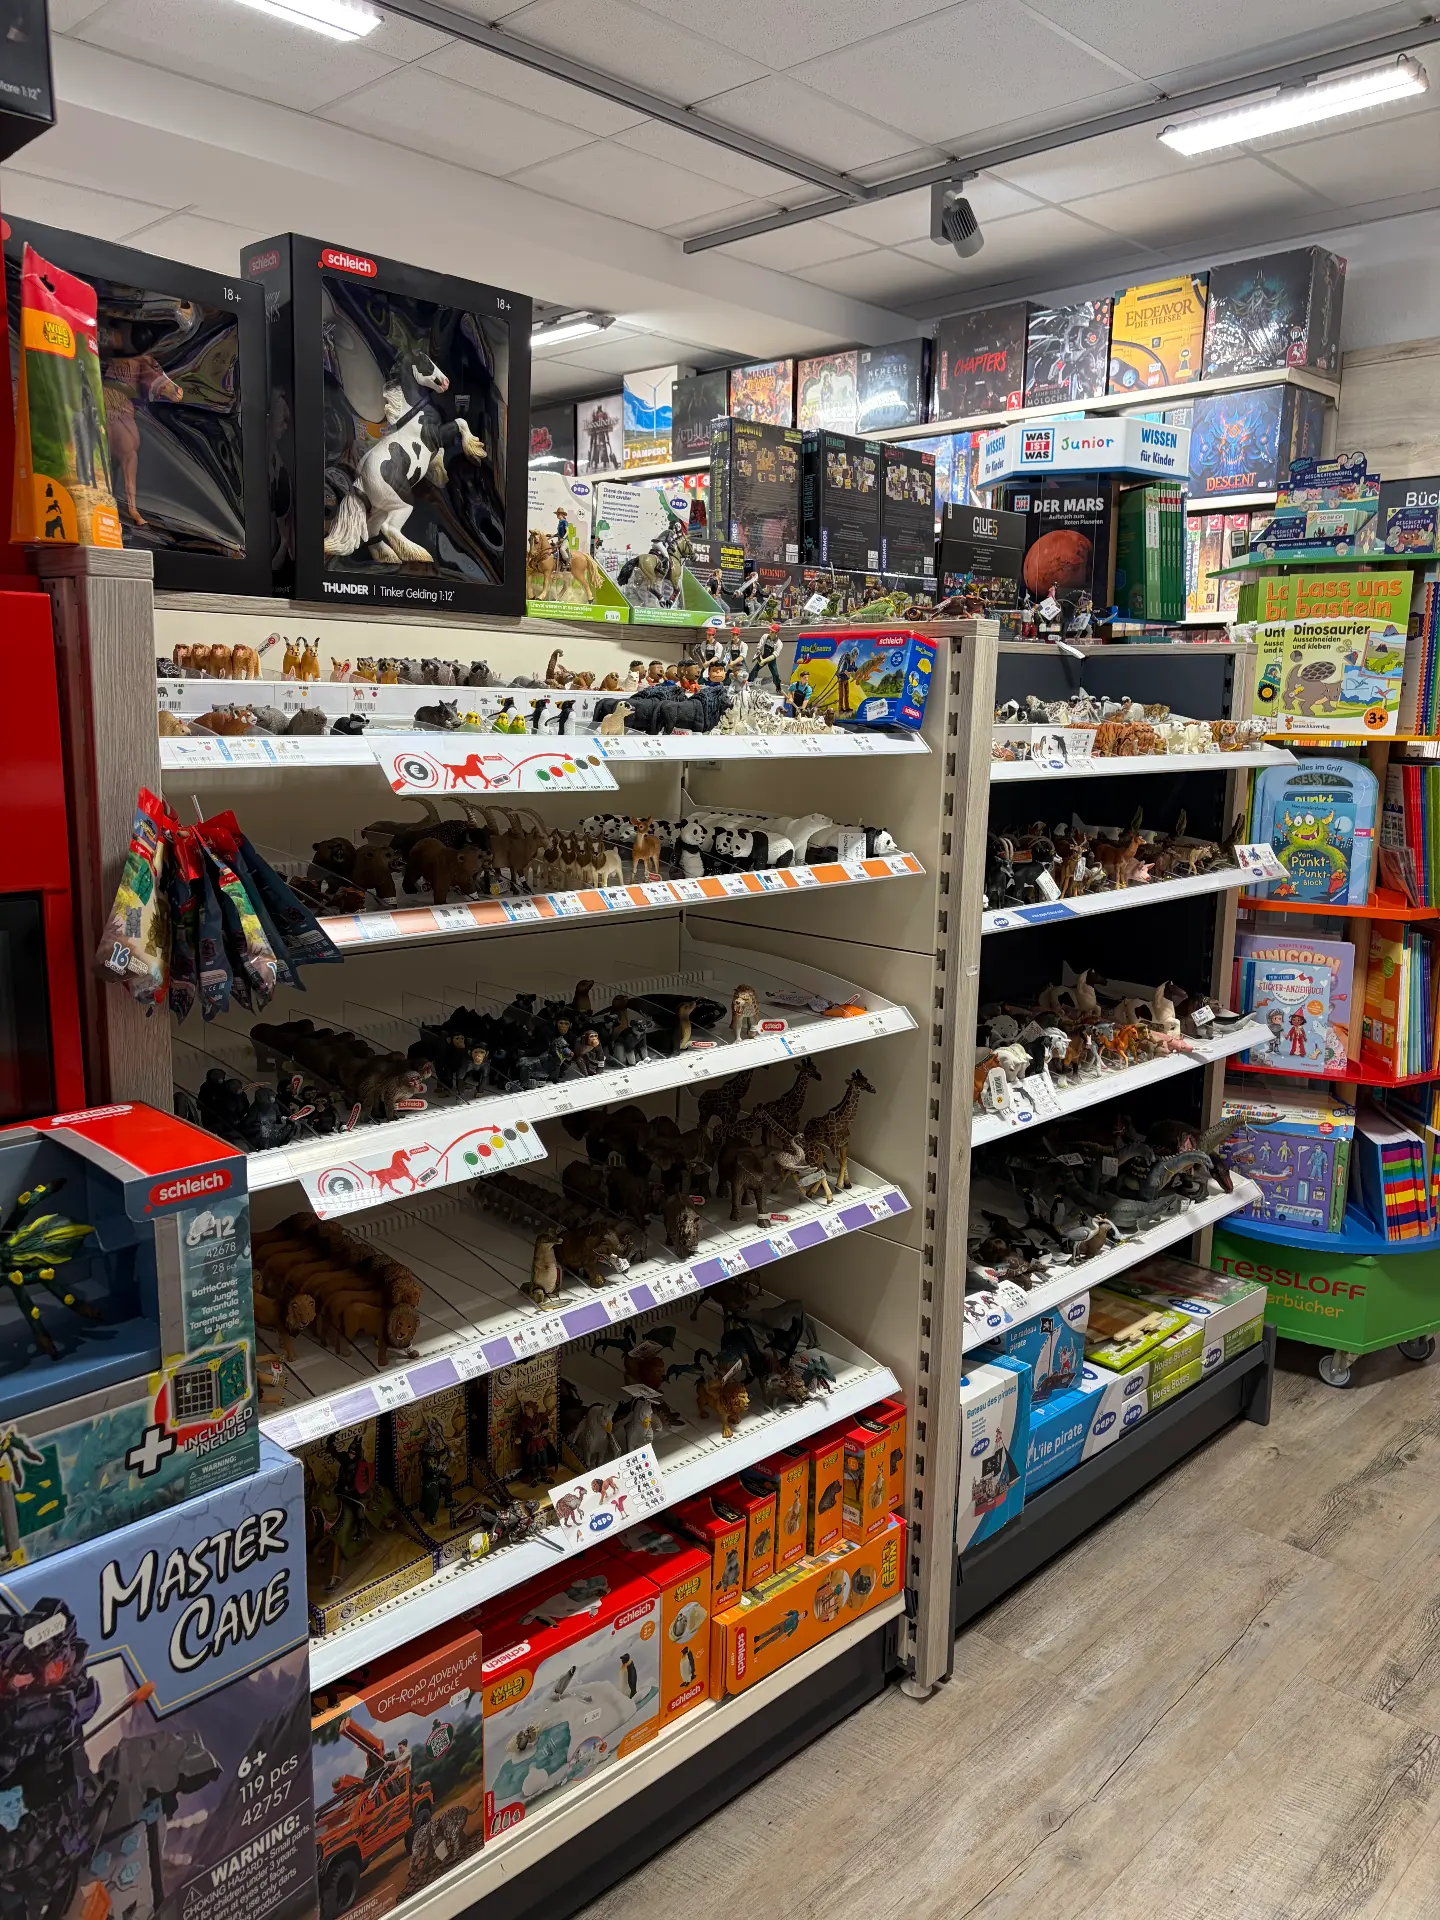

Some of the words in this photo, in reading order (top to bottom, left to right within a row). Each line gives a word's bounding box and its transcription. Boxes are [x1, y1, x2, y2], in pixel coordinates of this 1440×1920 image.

[251, 254, 277, 271] schleich
[328, 253, 371, 273] schleich
[223, 287, 242, 303] 18+
[496, 297, 512, 311] 18+
[1125, 298, 1196, 328] ENDEAVOR
[1134, 318, 1150, 329] DIE
[1150, 313, 1182, 326] TIEFSEE
[44, 320, 69, 338] WILD
[47, 333, 70, 348] LIFE
[868, 364, 908, 377] NEMESIS
[953, 350, 1007, 377] CHAPTERS
[747, 368, 774, 379] MARVEL
[1027, 394, 1067, 406] MOLOCHS
[1026, 431, 1050, 441] WAS
[1061, 436, 1115, 450] Junior
[1141, 427, 1178, 448] WISSEN
[631, 447, 667, 459] PAMPERO
[985, 435, 1005, 457] WISSEN
[1029, 442, 1047, 450] IST
[1025, 450, 1050, 460] WAS
[1140, 450, 1152, 463] für
[1152, 452, 1175, 466] Kinder
[991, 459, 1004, 472] Kinder
[573, 484, 590, 494] papo
[1205, 472, 1257, 492] DESCENT
[671, 500, 688, 509] papo
[1034, 499, 1060, 514] DER
[1063, 497, 1104, 513] MARS
[972, 516, 998, 537] CLUE5
[1080, 518, 1104, 526] Planeten
[322, 581, 369, 596] THUNDER
[380, 586, 404, 598] Tinker
[405, 588, 437, 603] Gelding
[1296, 578, 1351, 598] Lass
[1356, 579, 1403, 597] uns
[1294, 598, 1392, 618] basteln
[1293, 622, 1370, 636] Dinosaurier
[801, 643, 832, 653] Dinosaurs
[879, 636, 904, 645] schleich
[1292, 635, 1341, 644] Ausschneiden
[904, 706, 920, 718] schleich
[1368, 713, 1385, 725] 3+
[1298, 763, 1314, 772] Alles
[1326, 764, 1344, 774] Griff
[1291, 857, 1331, 868] Punkt-
[1298, 869, 1331, 879] Punkt-
[1303, 879, 1323, 887] Block
[111, 943, 129, 967] 16
[1250, 949, 1341, 976] UNICORN
[1258, 981, 1324, 996] STICKER-ANZIEHBUCH
[62, 1104, 125, 1122] schleich
[1226, 1108, 1279, 1118] SCHABLONEN
[159, 1174, 224, 1201] schleich
[206, 1242, 236, 1259] 42678
[212, 1262, 225, 1275] 28
[226, 1263, 238, 1273] pcs
[191, 1277, 238, 1298] BattleCave:
[212, 1288, 239, 1304] Jungle
[201, 1298, 239, 1315] Tarantula
[1070, 1306, 1085, 1320] papo
[1174, 1300, 1208, 1314] papo
[190, 1312, 227, 1331] Tarentule
[228, 1308, 240, 1318] de
[204, 1325, 213, 1335] la
[213, 1317, 240, 1334] Jungle
[988, 1315, 1001, 1325] papo
[1011, 1332, 1019, 1341] Le
[1018, 1326, 1037, 1338] radeau
[1010, 1339, 1027, 1353] pirate
[1154, 1357, 1174, 1373] Horse
[1173, 1345, 1192, 1360] Boxes
[1205, 1351, 1221, 1365] papo
[1126, 1379, 1143, 1394] papo
[1152, 1383, 1171, 1402] Horse
[1171, 1373, 1190, 1389] Boxes
[967, 1402, 987, 1420] Bateau
[987, 1396, 998, 1408] des
[997, 1384, 1017, 1404] pirates
[1125, 1406, 1142, 1423] papo
[183, 1406, 253, 1453] INCLUDED
[1095, 1414, 1115, 1434] papo
[196, 1421, 247, 1458] INCLUS
[1055, 1422, 1083, 1453] pirate
[973, 1440, 988, 1455] papo
[201, 1455, 237, 1474] WARNING:
[189, 1472, 211, 1486] CHOKING
[591, 1514, 612, 1530] papo
[721, 1532, 740, 1544] WILD
[821, 1529, 837, 1544] schleich
[784, 1545, 802, 1560] schleich
[753, 1564, 770, 1577] schleich
[882, 1548, 890, 1586] LIFE
[889, 1540, 897, 1584] WILD
[102, 1508, 289, 1637] MASTER
[676, 1576, 700, 1598] WILD
[676, 1584, 698, 1602] LIFE
[719, 1591, 737, 1603] schleich
[169, 1569, 290, 1673] CAVE
[619, 1602, 651, 1627] schleich
[485, 1645, 526, 1670] schleich
[737, 1632, 746, 1675] schleich
[377, 1678, 427, 1714] OFF-ROAD
[427, 1651, 478, 1689] ADVENTURE
[492, 1675, 523, 1699] WILD
[494, 1683, 522, 1706] LIFE
[671, 1684, 701, 1711] schleich
[238, 1751, 267, 1778] 6+
[240, 1780, 265, 1803] 119
[270, 1755, 298, 1792] pcs
[240, 1780, 293, 1827] 42757
[211, 1814, 300, 1888] WARNING:
[183, 1884, 227, 1920] CHOKING
[227, 1858, 264, 1890] HAZARD
[269, 1838, 291, 1859] Small
[292, 1824, 311, 1844] parts.
[200, 1906, 211, 1920] for
[213, 1885, 245, 1913] children
[245, 1867, 268, 1889] under
[276, 1846, 299, 1868] years.
[240, 1886, 259, 1904] eyes
[269, 1865, 288, 1883] face.
[245, 1896, 261, 1910] use
[261, 1881, 278, 1900] only
[278, 1867, 297, 1887] darts
[252, 1890, 283, 1920] product.
